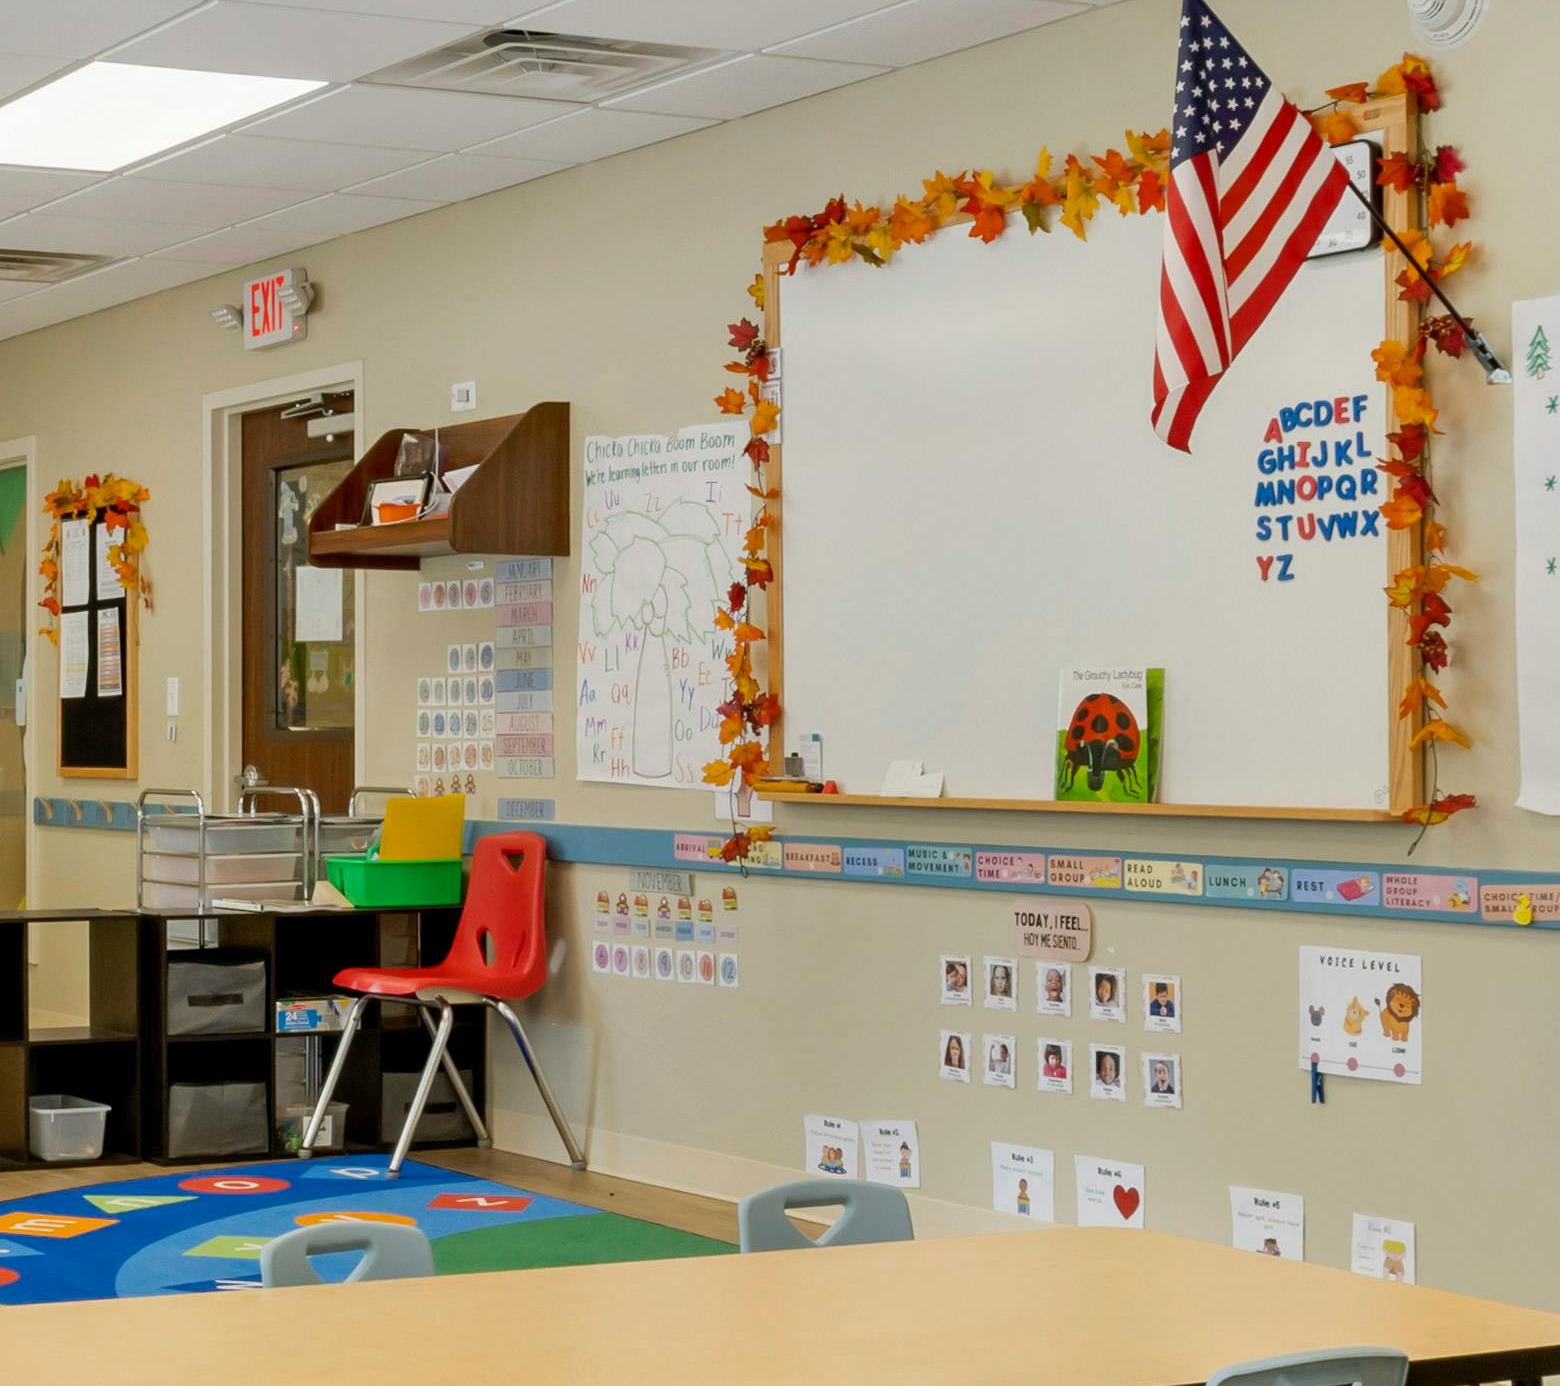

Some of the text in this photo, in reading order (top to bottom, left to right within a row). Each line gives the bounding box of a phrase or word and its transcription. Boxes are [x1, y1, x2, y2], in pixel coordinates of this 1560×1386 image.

[251, 276, 285, 337] EXIT
[587, 432, 735, 463] Chicka Chicka Boom Boom
[609, 465, 640, 483] learning
[641, 461, 667, 476] letters
[682, 460, 698, 472] our
[702, 455, 735, 471] room!
[504, 583, 542, 601] FEBRUARY
[503, 737, 545, 754] SEPTEMBER
[508, 760, 542, 776] OCTOBER
[676, 842, 706, 854] ARRIVAL
[786, 852, 830, 863] BREAKFAST
[908, 849, 948, 861] MUSIC &
[846, 856, 878, 867] RECESS
[908, 861, 960, 874] MOVEMENT
[978, 856, 1015, 868] CHOICE
[1051, 859, 1084, 871] SMALL
[978, 868, 1001, 879] TIME
[1127, 864, 1154, 875] READ
[637, 871, 683, 892] NOVEMBER
[1051, 872, 1085, 883] GROUP
[1127, 878, 1162, 889] ALOUD
[1209, 876, 1247, 888] LUNCH
[1386, 875, 1418, 886] WHOLE
[1297, 880, 1324, 893] REST
[1386, 885, 1418, 896] GROUP
[1386, 897, 1432, 908] LITERACY
[1014, 912, 1053, 930] TODAY,
[1055, 915, 1058, 928] I
[1024, 933, 1039, 946] HOY
[1041, 934, 1051, 948] ME
[1320, 955, 1401, 975] VOICE LEVEL
